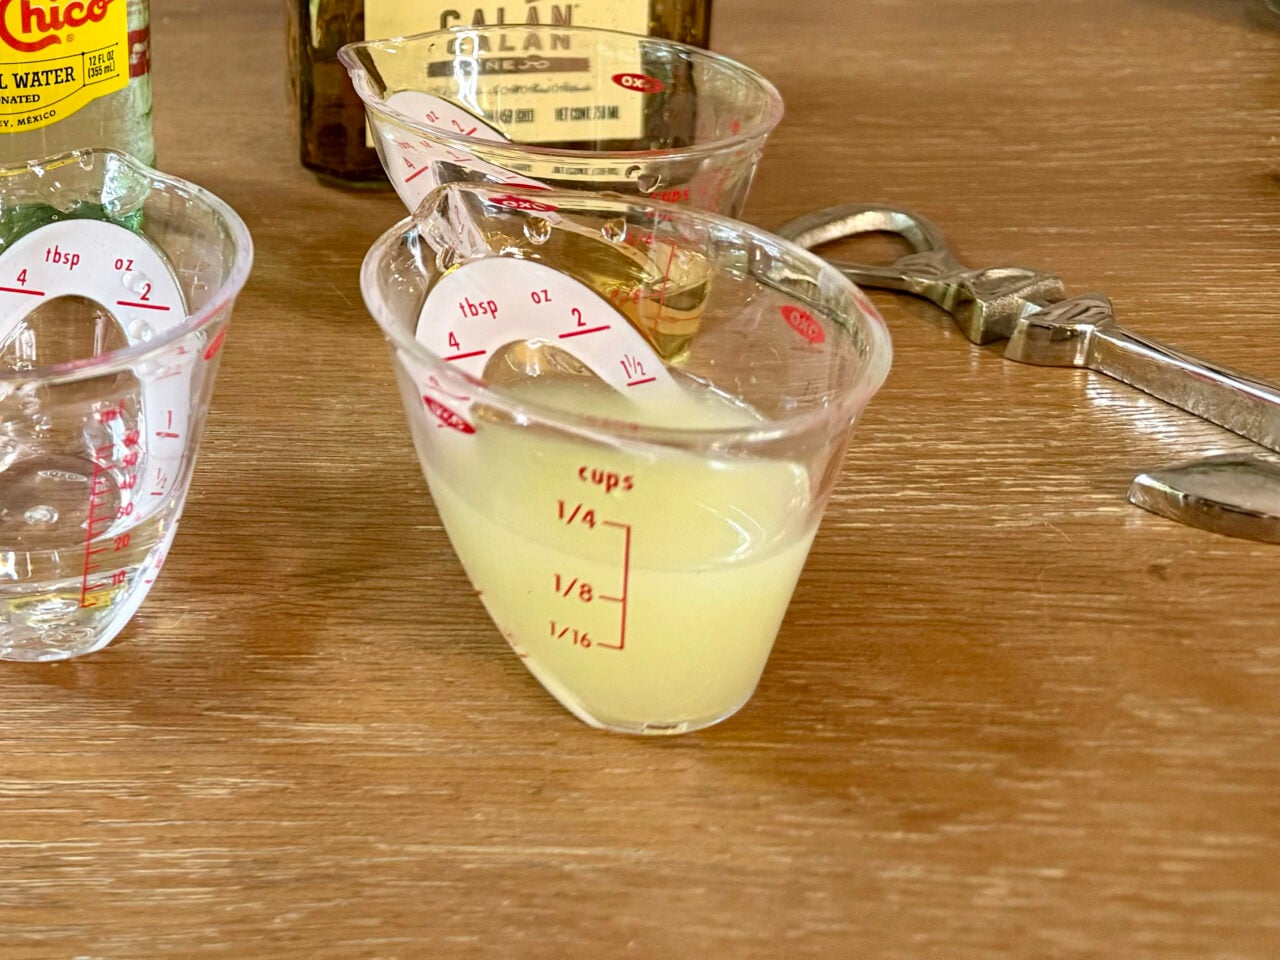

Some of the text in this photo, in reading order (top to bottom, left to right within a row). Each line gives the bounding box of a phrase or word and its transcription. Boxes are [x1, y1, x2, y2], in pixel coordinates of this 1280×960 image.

[88, 55, 97, 66] 12
[98, 52, 106, 63] FL
[107, 49, 114, 61] OZ
[12, 66, 76, 89] WATER
[87, 64, 103, 79] (355
[17, 109, 57, 126] MÉXICO
[402, 156, 416, 169] 4
[44, 244, 134, 272] tbsp oz
[16, 268, 28, 286] 4
[140, 282, 152, 302] 2
[459, 289, 552, 320] tbsp oz
[571, 307, 587, 327] 2
[448, 331, 461, 351] 4
[578, 465, 634, 493] cups
[557, 499, 597, 529] 1/4
[554, 573, 593, 603] 1/8
[550, 620, 592, 649] 1/16
